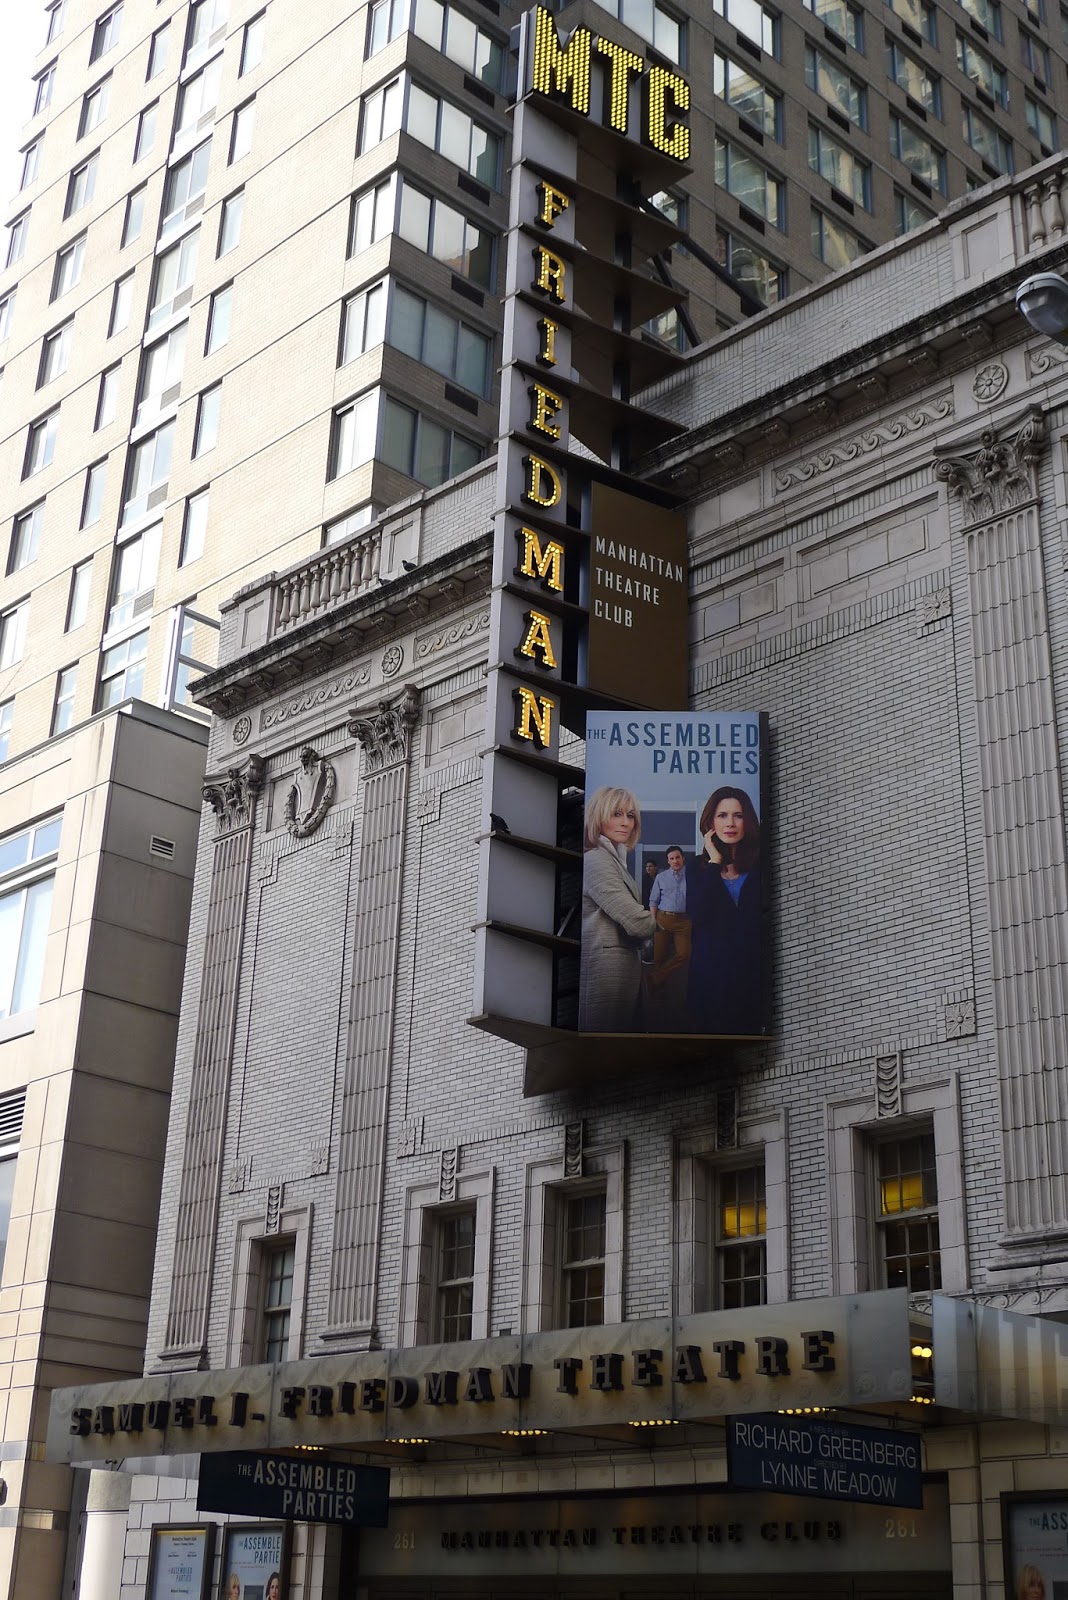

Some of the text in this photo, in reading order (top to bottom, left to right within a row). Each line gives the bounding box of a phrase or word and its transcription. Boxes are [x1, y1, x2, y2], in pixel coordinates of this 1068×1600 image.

[533, 5, 690, 161] MTC
[512, 181, 570, 750] FRIEDMAN
[596, 535, 684, 583] MANHATTAN
[596, 567, 660, 605] THEATRE
[595, 599, 633, 628] CLUB
[588, 722, 759, 748] THE ASSEMBLED
[653, 749, 759, 775] PARTIES
[70, 1395, 217, 1436] SAMUEL
[279, 1363, 532, 1418] FRIEDMAN
[553, 1330, 836, 1395] THEATRE
[735, 1422, 917, 1469] RICHARD GREENBERG
[238, 1459, 356, 1493] THE ASSEMBLED
[761, 1460, 897, 1498] LYNNE MEADOW
[283, 1489, 354, 1520] PARTIES
[394, 1532, 415, 1549] 261
[441, 1520, 843, 1549] MANHATTAN THEATRE CLUB
[885, 1519, 918, 1538] 261
